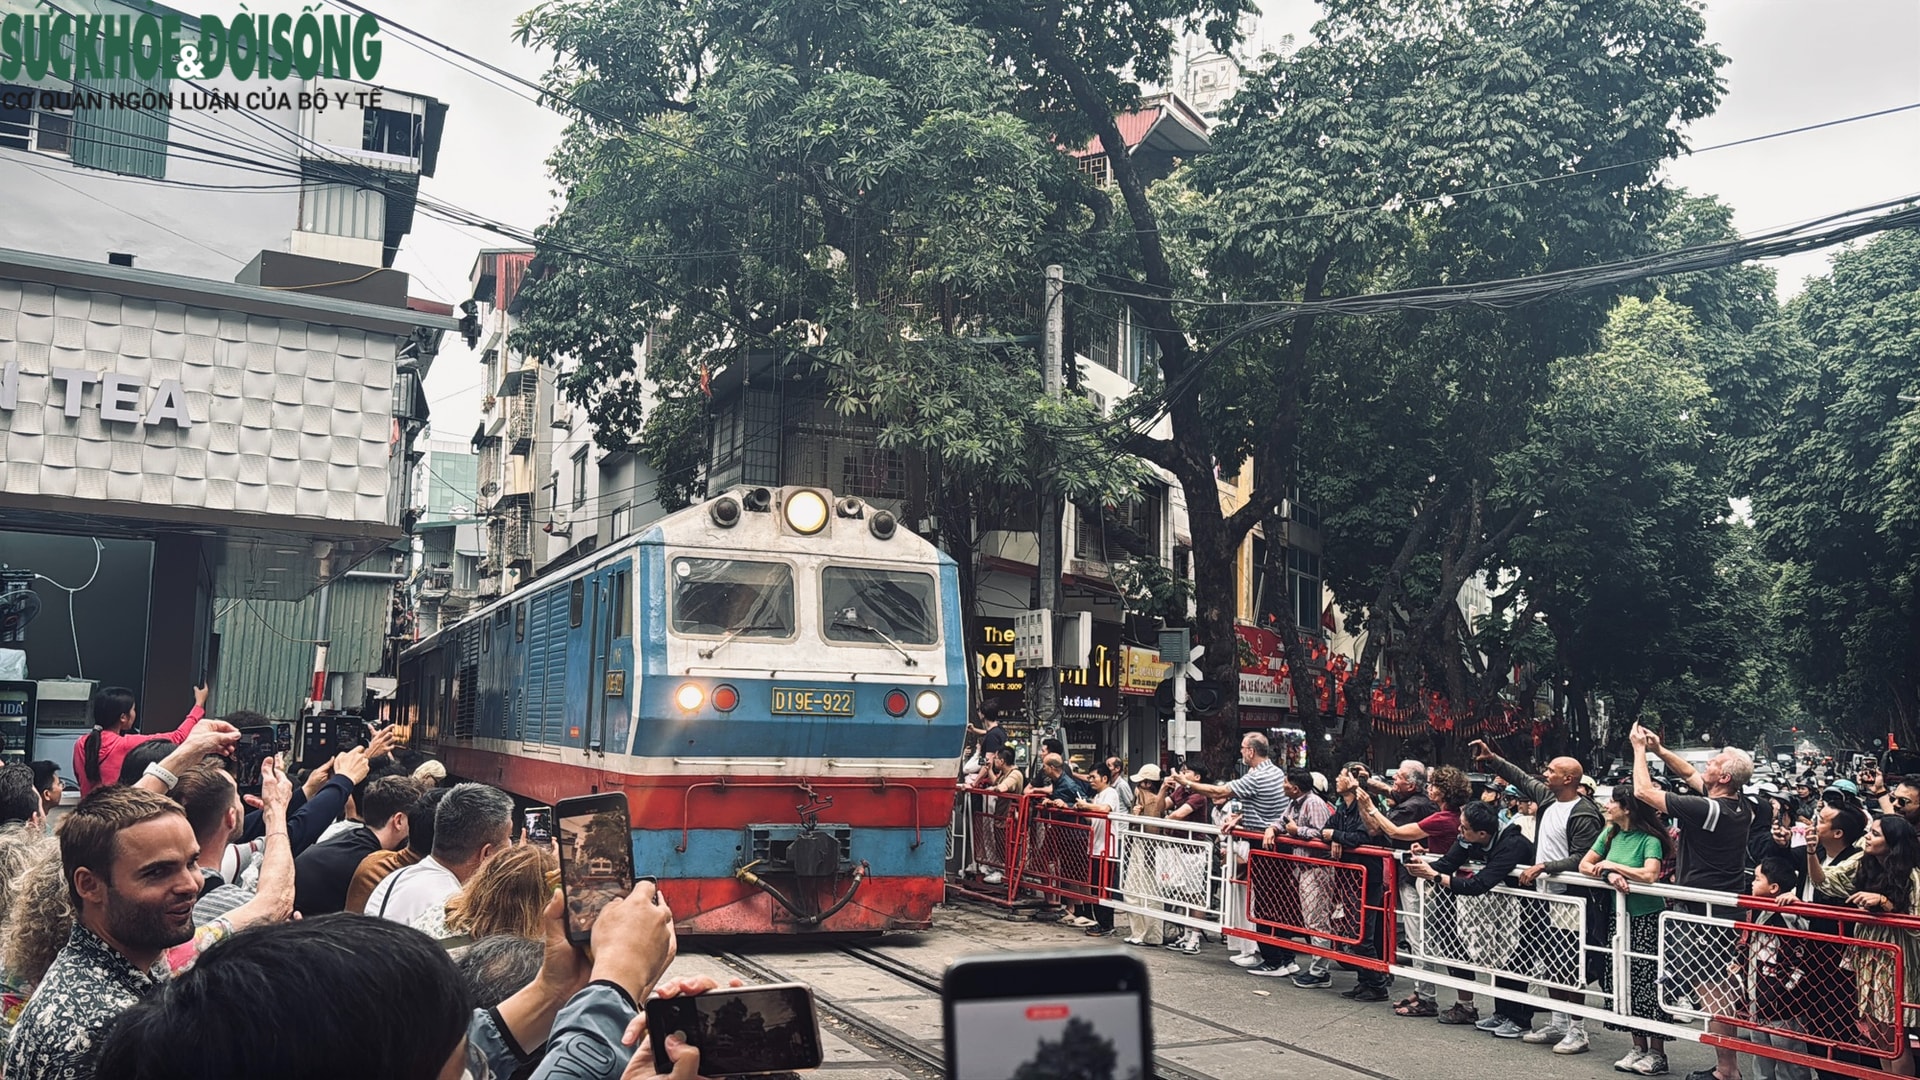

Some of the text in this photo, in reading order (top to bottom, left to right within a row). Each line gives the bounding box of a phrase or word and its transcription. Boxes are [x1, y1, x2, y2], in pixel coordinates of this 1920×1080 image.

[52, 366, 193, 429] TEA
[984, 626, 1016, 643] The
[986, 682, 1005, 690] SINCE
[0, 703, 23, 715] IDA
[776, 691, 851, 712] D19E-922
